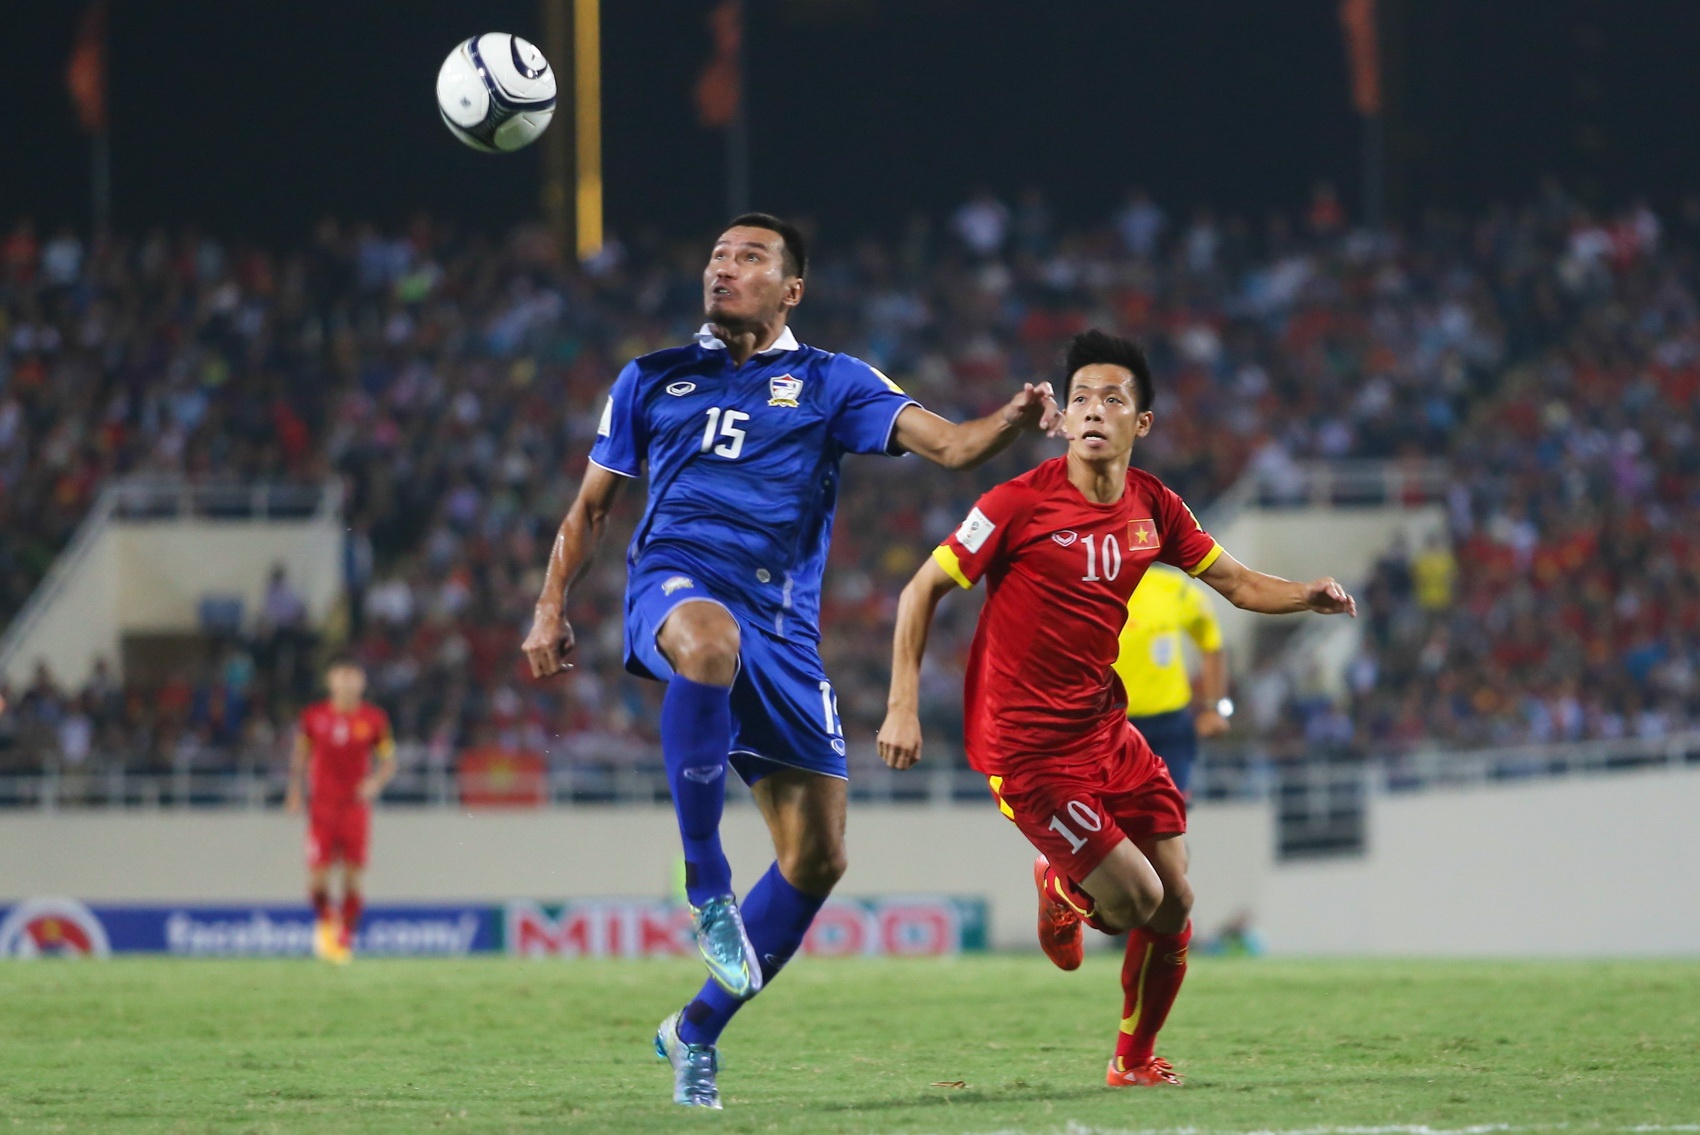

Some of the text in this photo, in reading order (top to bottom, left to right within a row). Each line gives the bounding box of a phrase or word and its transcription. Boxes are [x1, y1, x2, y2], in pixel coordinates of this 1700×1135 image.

[701, 407, 750, 459] 15
[1081, 533, 1122, 582] 10
[819, 681, 843, 737] 1
[1049, 800, 1101, 855] 10
